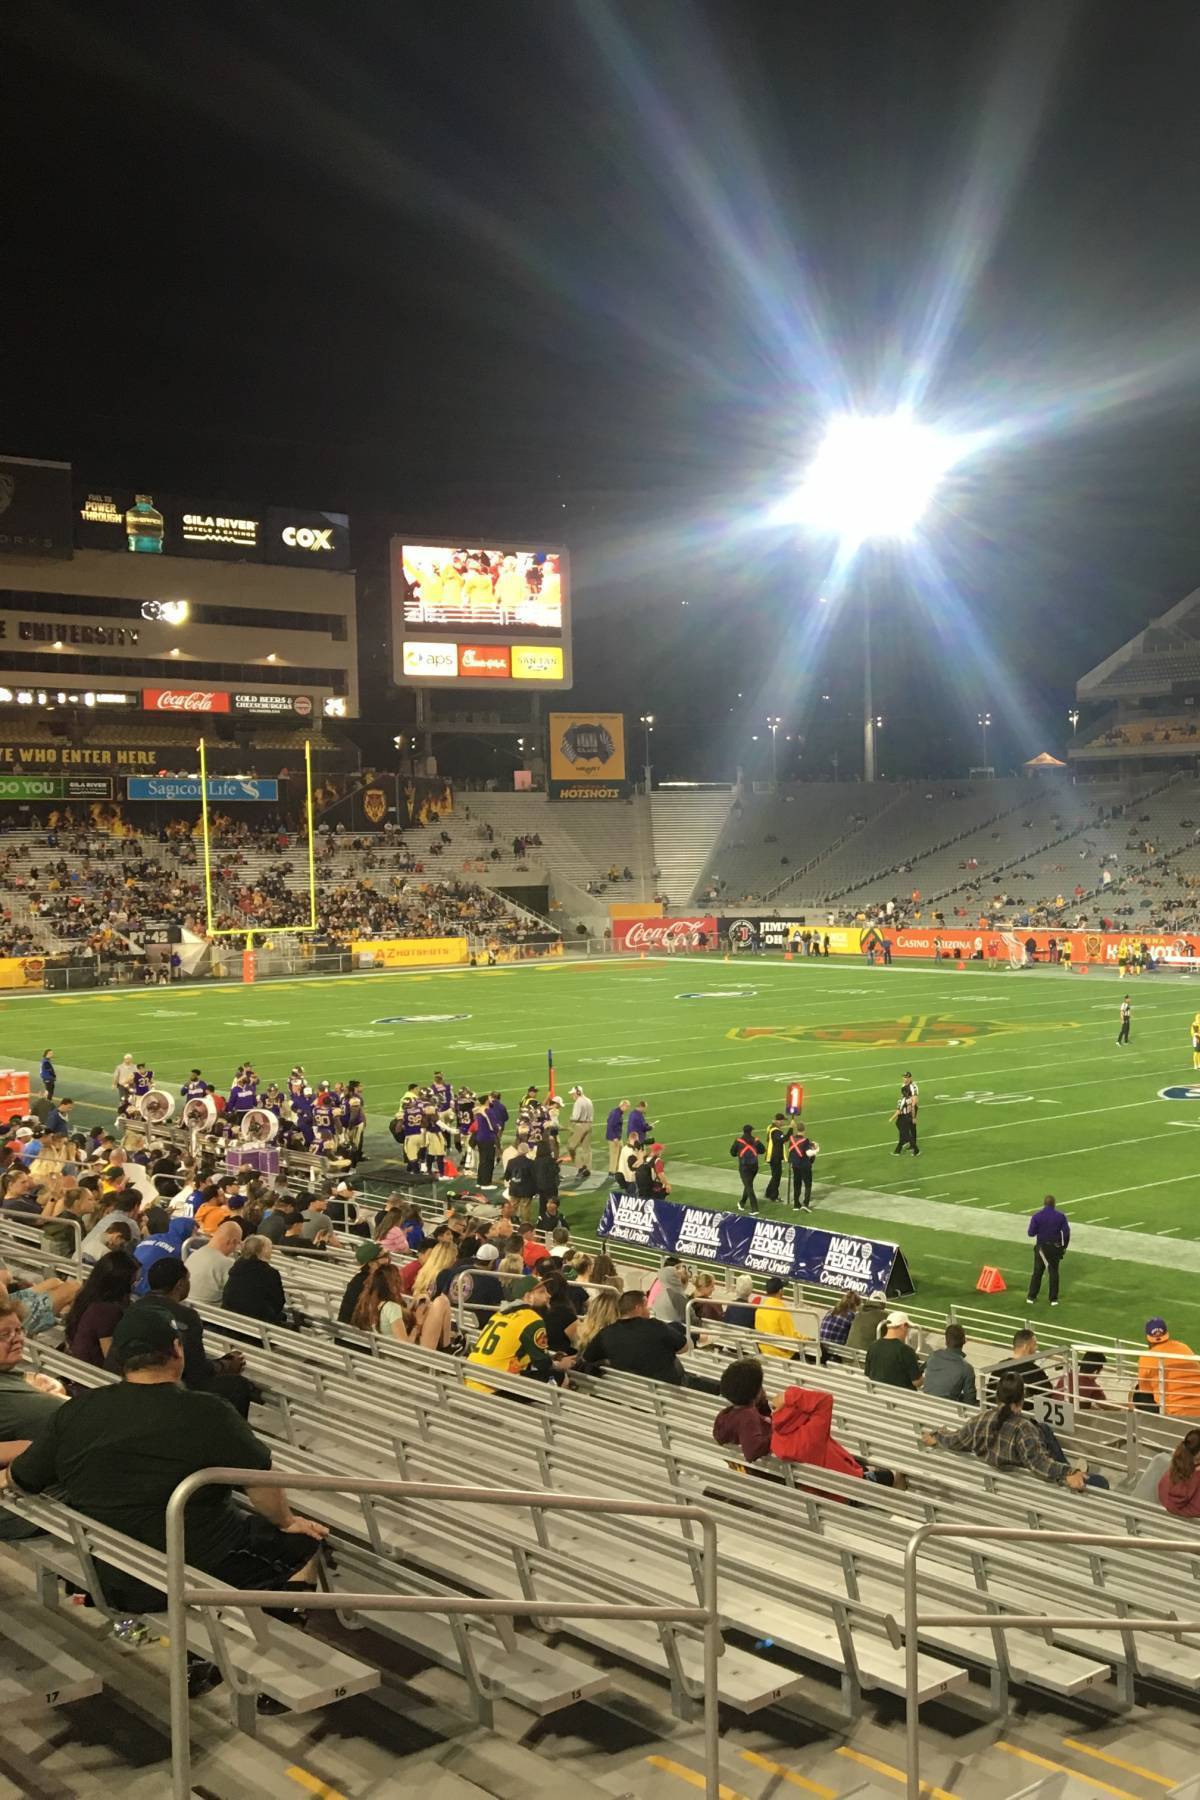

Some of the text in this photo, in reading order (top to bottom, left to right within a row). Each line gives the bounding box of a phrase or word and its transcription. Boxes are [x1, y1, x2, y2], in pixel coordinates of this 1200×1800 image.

[85, 501, 117, 513] POWER
[183, 515, 255, 531] GILA RIVER
[282, 527, 333, 551] COX
[19, 621, 139, 646] UNIVERSITY
[426, 654, 453, 667] aps
[157, 690, 215, 711] Coca-Cola
[20, 749, 56, 763] WHO
[62, 750, 112, 764] ENTER
[117, 751, 156, 765] HERE
[23, 781, 54, 793] YOU
[209, 781, 237, 795] Life
[560, 788, 619, 799] HOTSHOTS
[896, 936, 929, 949] CASINO
[618, 1195, 644, 1211] NAVY
[615, 1208, 655, 1227] FEDERAL
[684, 1209, 712, 1226] NAVY
[608, 1224, 650, 1243] Credit Union
[680, 1222, 720, 1242] FEDERAL
[754, 1222, 785, 1239] NAVY
[675, 1239, 716, 1259] Credit Union
[749, 1236, 795, 1258] FEDERAL
[829, 1237, 861, 1256] NAVY
[745, 1254, 791, 1275] Credit Union
[824, 1252, 872, 1275] FEDERAL
[820, 1271, 868, 1294] Credit Union
[1043, 1402, 1065, 1426] 25
[46, 1690, 60, 1703] 17
[334, 1687, 346, 1698] 16
